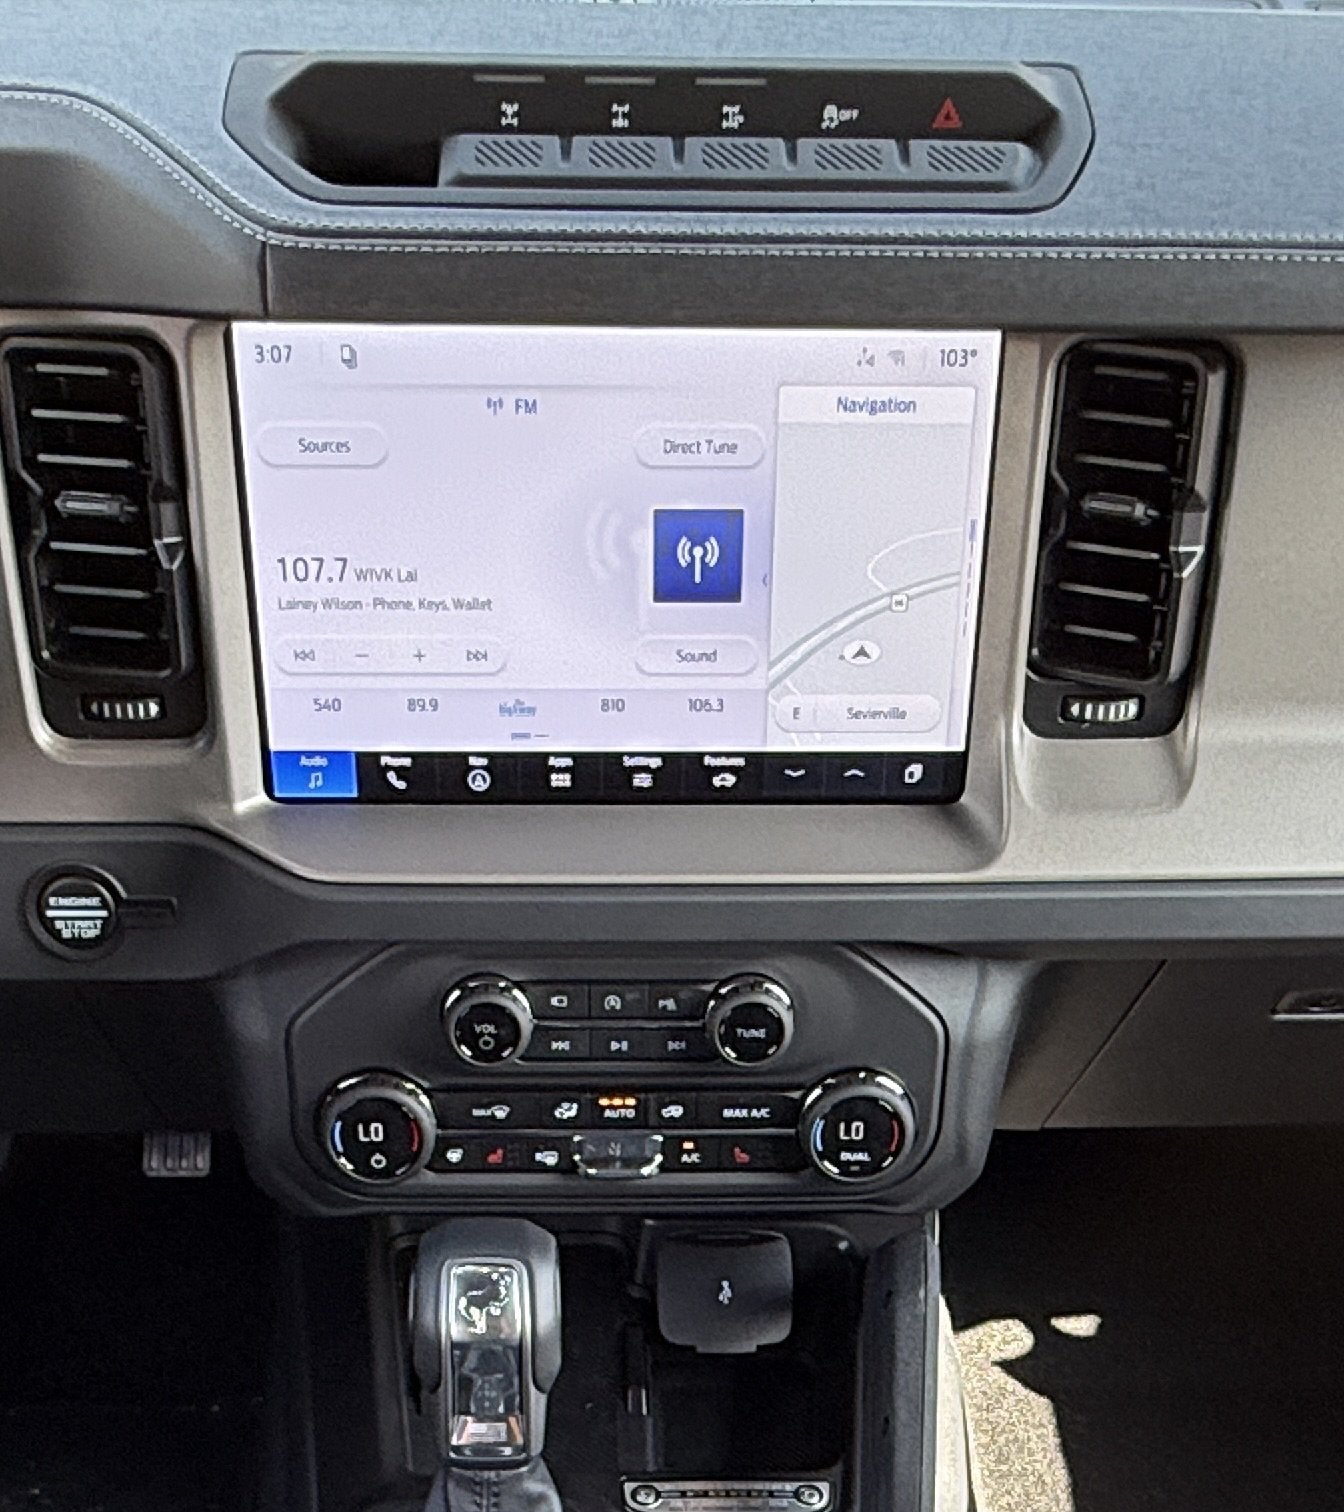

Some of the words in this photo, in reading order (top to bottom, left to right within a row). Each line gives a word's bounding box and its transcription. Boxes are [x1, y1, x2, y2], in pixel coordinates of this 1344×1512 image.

[839, 108, 859, 121] OFF
[254, 345, 292, 363] 3:07
[514, 398, 538, 414] FM
[836, 396, 917, 415] Navigation
[298, 438, 351, 453] Sources
[663, 439, 701, 454] Direct
[706, 439, 738, 454] Tune
[277, 557, 348, 583] 107.7
[354, 567, 393, 582] WIVK
[278, 597, 316, 613] Lainey
[320, 597, 363, 610] Wilson
[451, 597, 493, 611] Wallet
[675, 649, 718, 663] Sound
[313, 698, 342, 712] 540
[406, 698, 439, 712] 89.9
[600, 698, 626, 712] 810
[687, 698, 724, 713] 106.3
[792, 706, 801, 720] E
[846, 706, 908, 720] Sevierville
[474, 1023, 498, 1034] VOL
[735, 1028, 766, 1039] TUNE
[604, 1108, 636, 1119] AUTO
[722, 1108, 748, 1119] MAX
[750, 1108, 771, 1119] A/C
[681, 1153, 701, 1164] A/C
